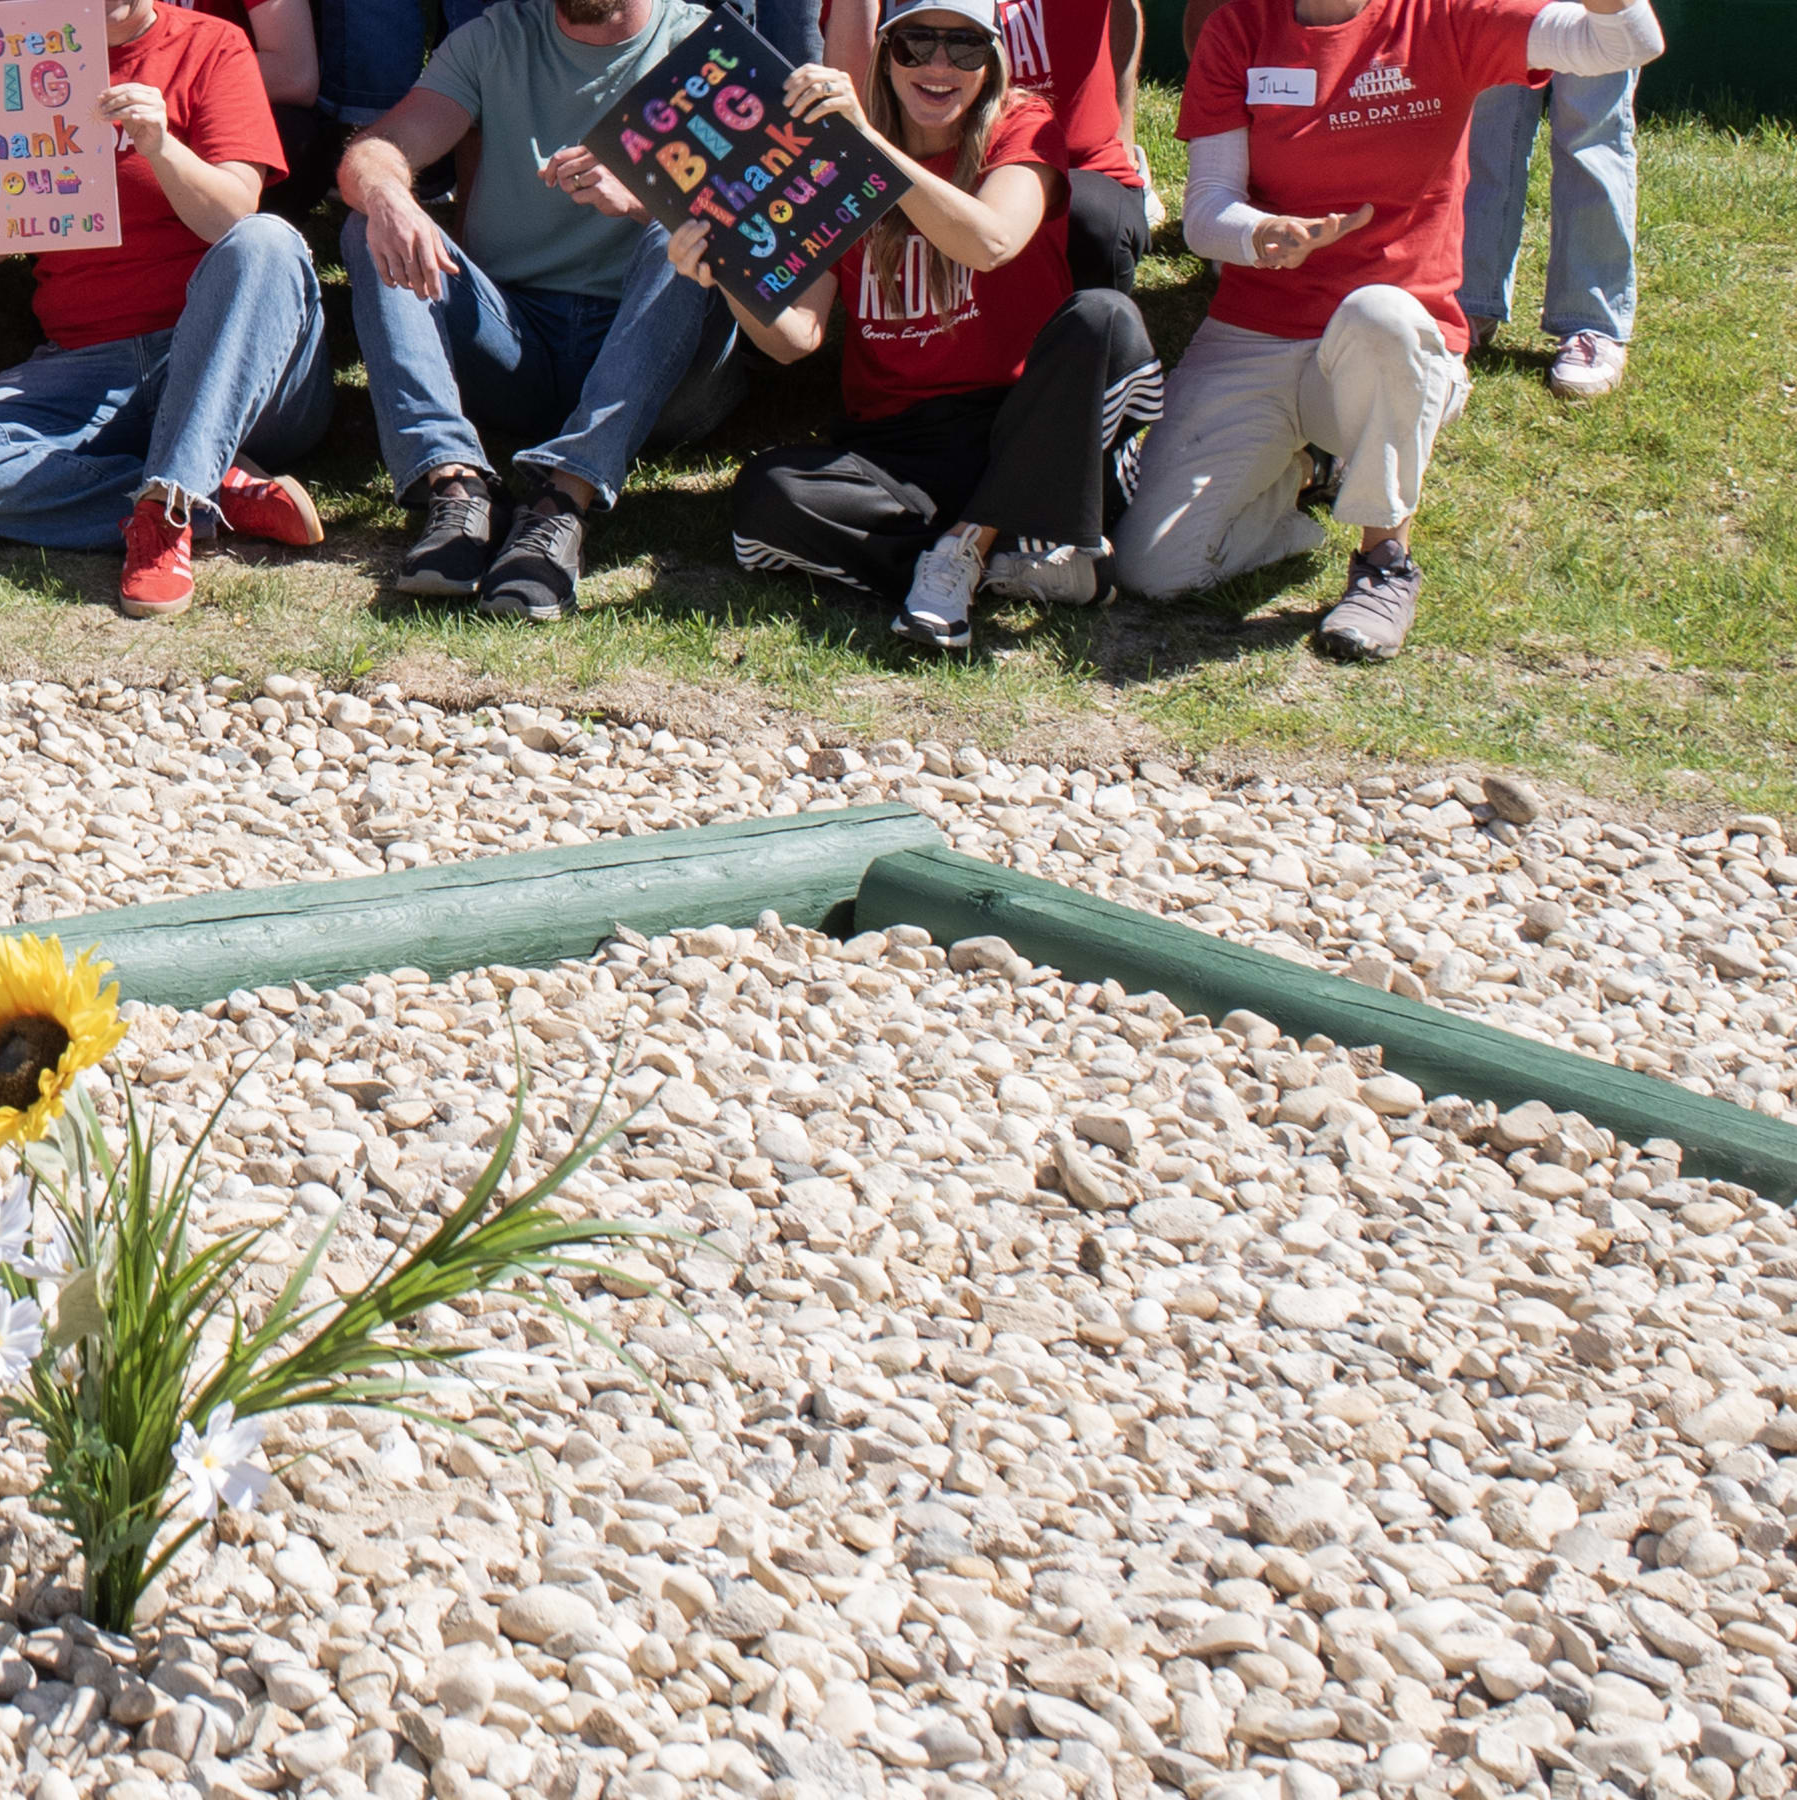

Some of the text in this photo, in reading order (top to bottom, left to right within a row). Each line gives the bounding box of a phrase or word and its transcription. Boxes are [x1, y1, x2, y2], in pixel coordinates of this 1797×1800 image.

[620, 47, 739, 165] A Great
[1258, 75, 1299, 95] JILL
[1328, 98, 1441, 125] RED DAY 2010
[1355, 67, 1404, 85] KELLER
[655, 84, 765, 195] BIG
[689, 121, 814, 229] Thank
[6, 216, 45, 237] ALL
[49, 214, 74, 237] OF
[81, 213, 105, 232] US
[737, 175, 818, 259] you
[756, 173, 888, 301] FROM ALL OF US
